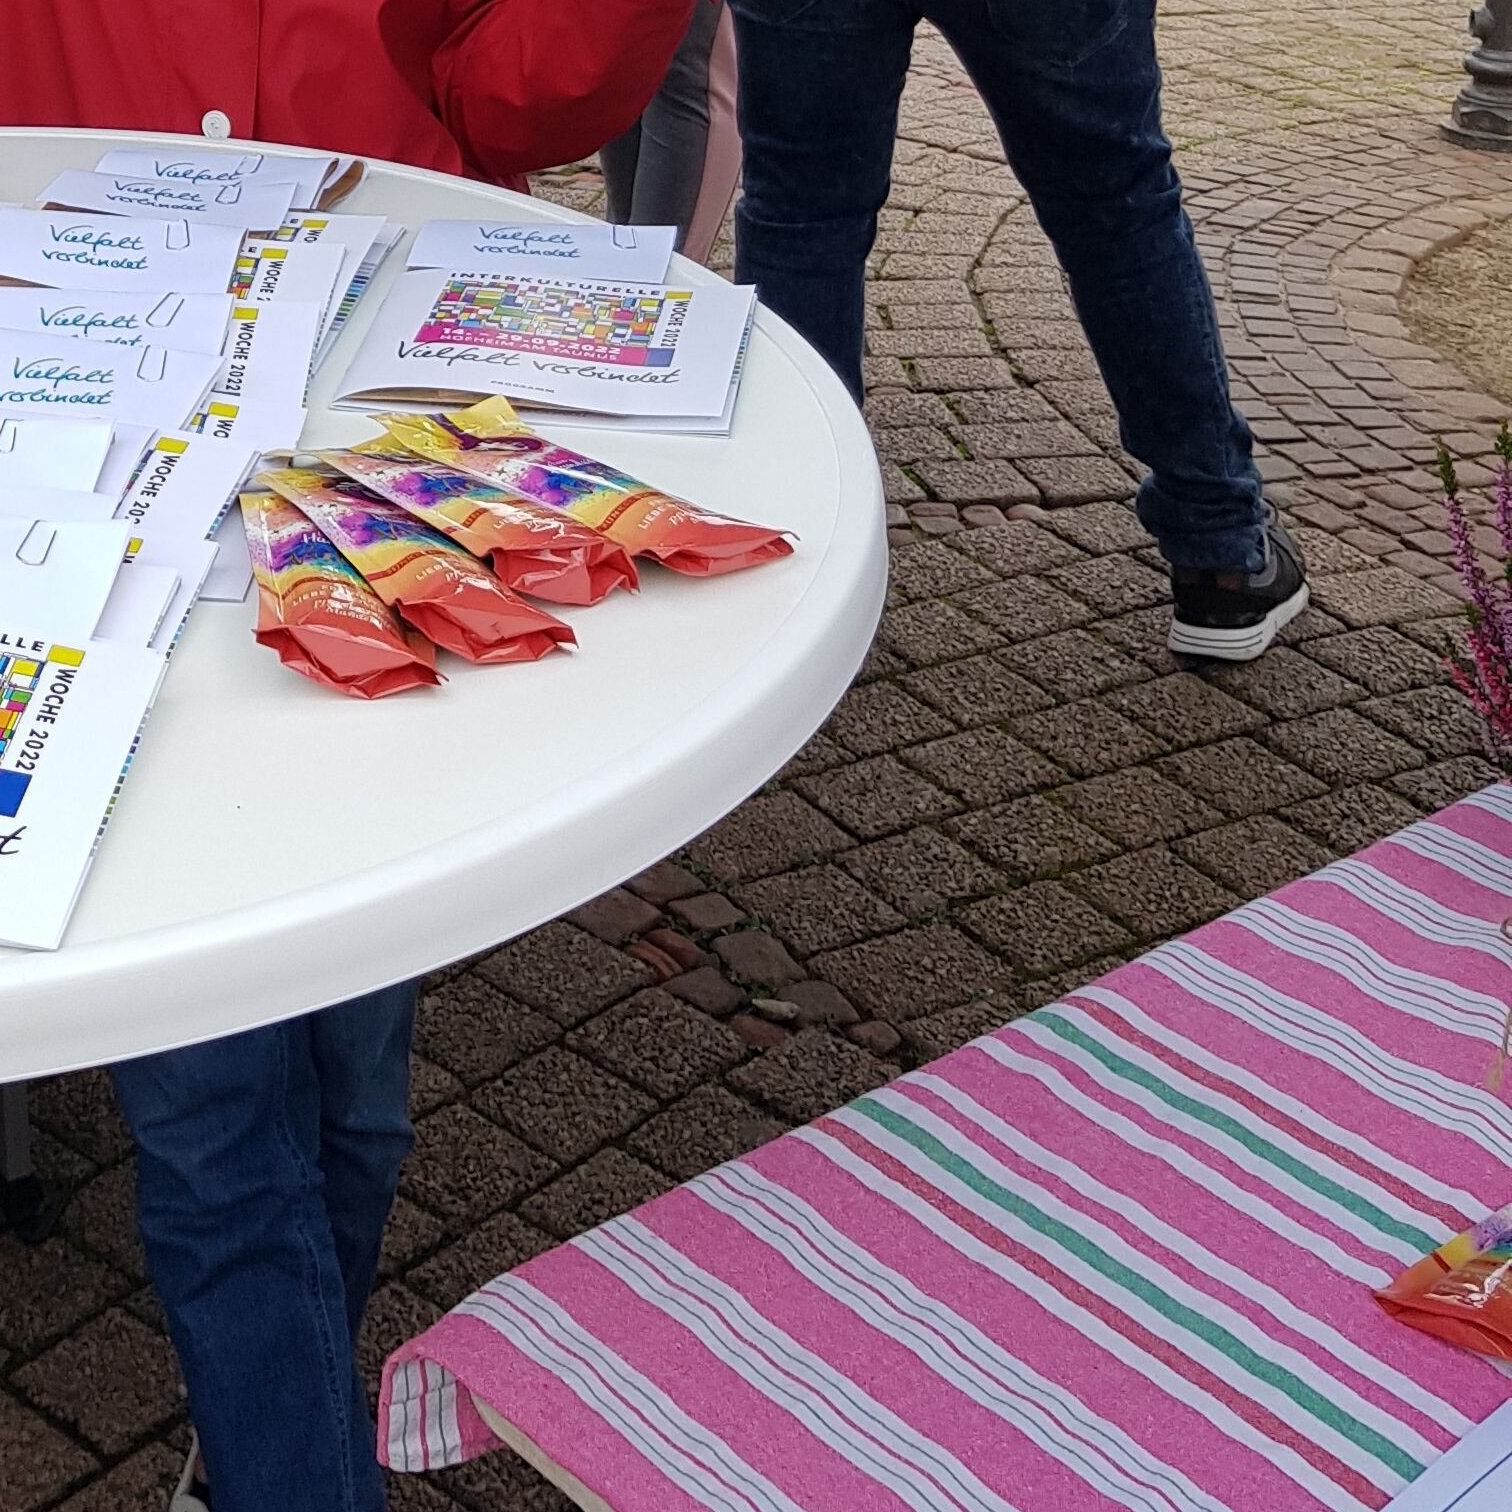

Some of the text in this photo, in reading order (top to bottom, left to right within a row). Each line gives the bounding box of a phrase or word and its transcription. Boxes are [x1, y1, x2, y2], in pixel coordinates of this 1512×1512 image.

[155, 160, 242, 182] Vielfalt
[106, 193, 207, 212] verbindet
[115, 180, 204, 202] Vielfalt
[49, 224, 145, 253] Vielfalt
[478, 226, 575, 246] Vielfalt
[41, 249, 148, 270] verbindet
[474, 244, 581, 259] verbindet
[259, 260, 285, 295] WOCHE
[450, 271, 661, 297] INTERKULTURELLE
[40, 306, 139, 337] Vielfalt
[659, 299, 689, 347] WOCHE 2022
[233, 321, 258, 361] WOCHE
[440, 333, 618, 361] HOFHEIM AM TAUNUS
[441, 326, 473, 338] 14.
[494, 333, 622, 356] 29.09.2022
[13, 357, 114, 393] Vielfalt
[397, 340, 681, 385] Vielfalt verbindet
[489, 379, 556, 394] PROGRAMM
[140, 454, 181, 500] WOCHE
[15, 668, 78, 772] WOCHE 2022
